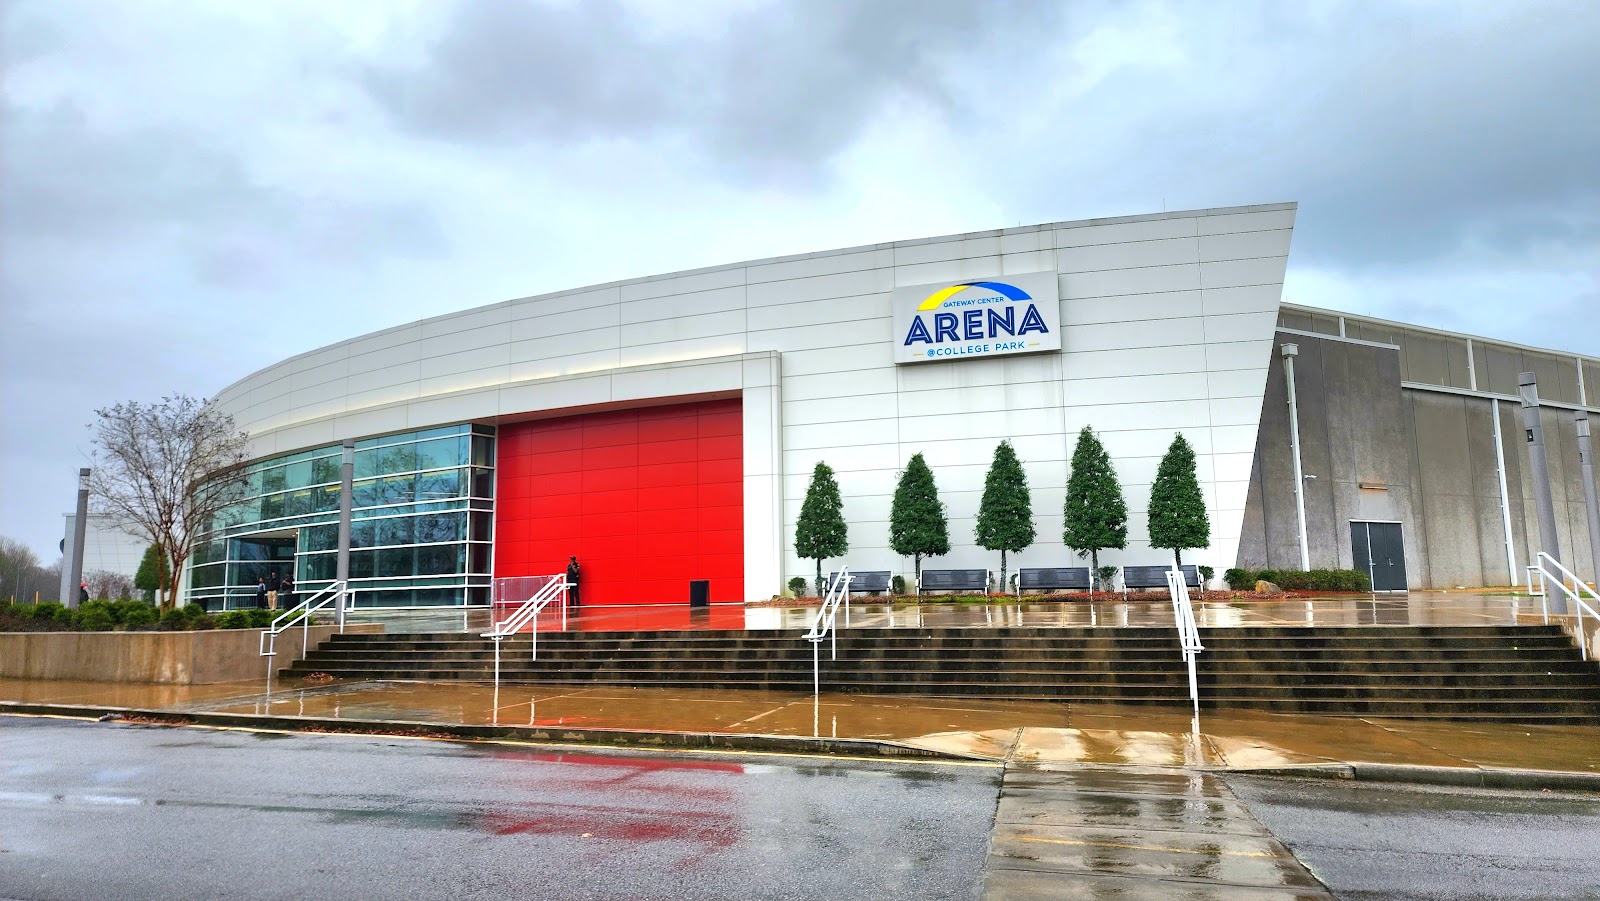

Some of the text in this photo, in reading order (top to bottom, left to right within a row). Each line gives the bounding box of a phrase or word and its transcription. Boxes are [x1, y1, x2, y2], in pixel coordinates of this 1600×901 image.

[943, 296, 1004, 308] GATEWAY CENTER
[904, 303, 1049, 346] ARENA
[927, 340, 1025, 357] @COLLEGE PARK
